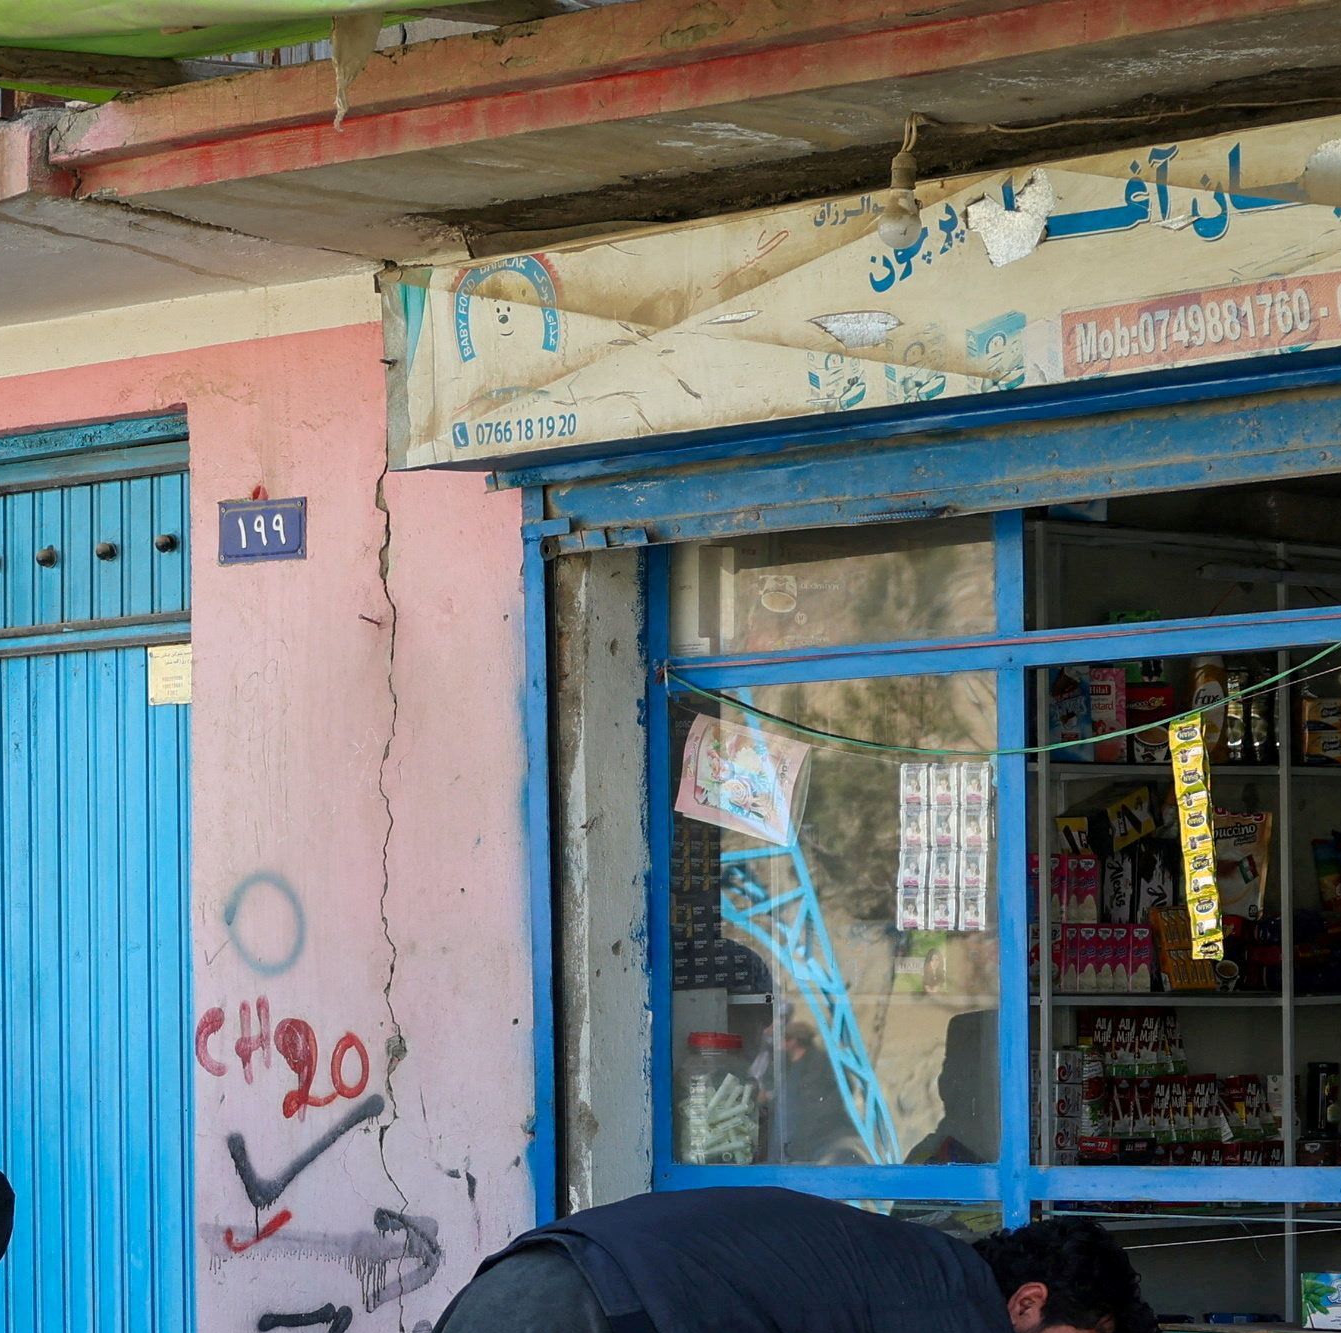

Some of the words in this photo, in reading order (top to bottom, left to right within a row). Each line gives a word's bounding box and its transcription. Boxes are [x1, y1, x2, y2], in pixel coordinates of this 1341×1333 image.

[459, 278, 476, 315] FOOD
[458, 322, 472, 357] BABY
[1075, 287, 1311, 365] Mob:0749881760
[475, 420, 511, 446] 0766
[516, 417, 534, 441] 18
[538, 415, 556, 439] 19
[558, 413, 577, 437] 20
